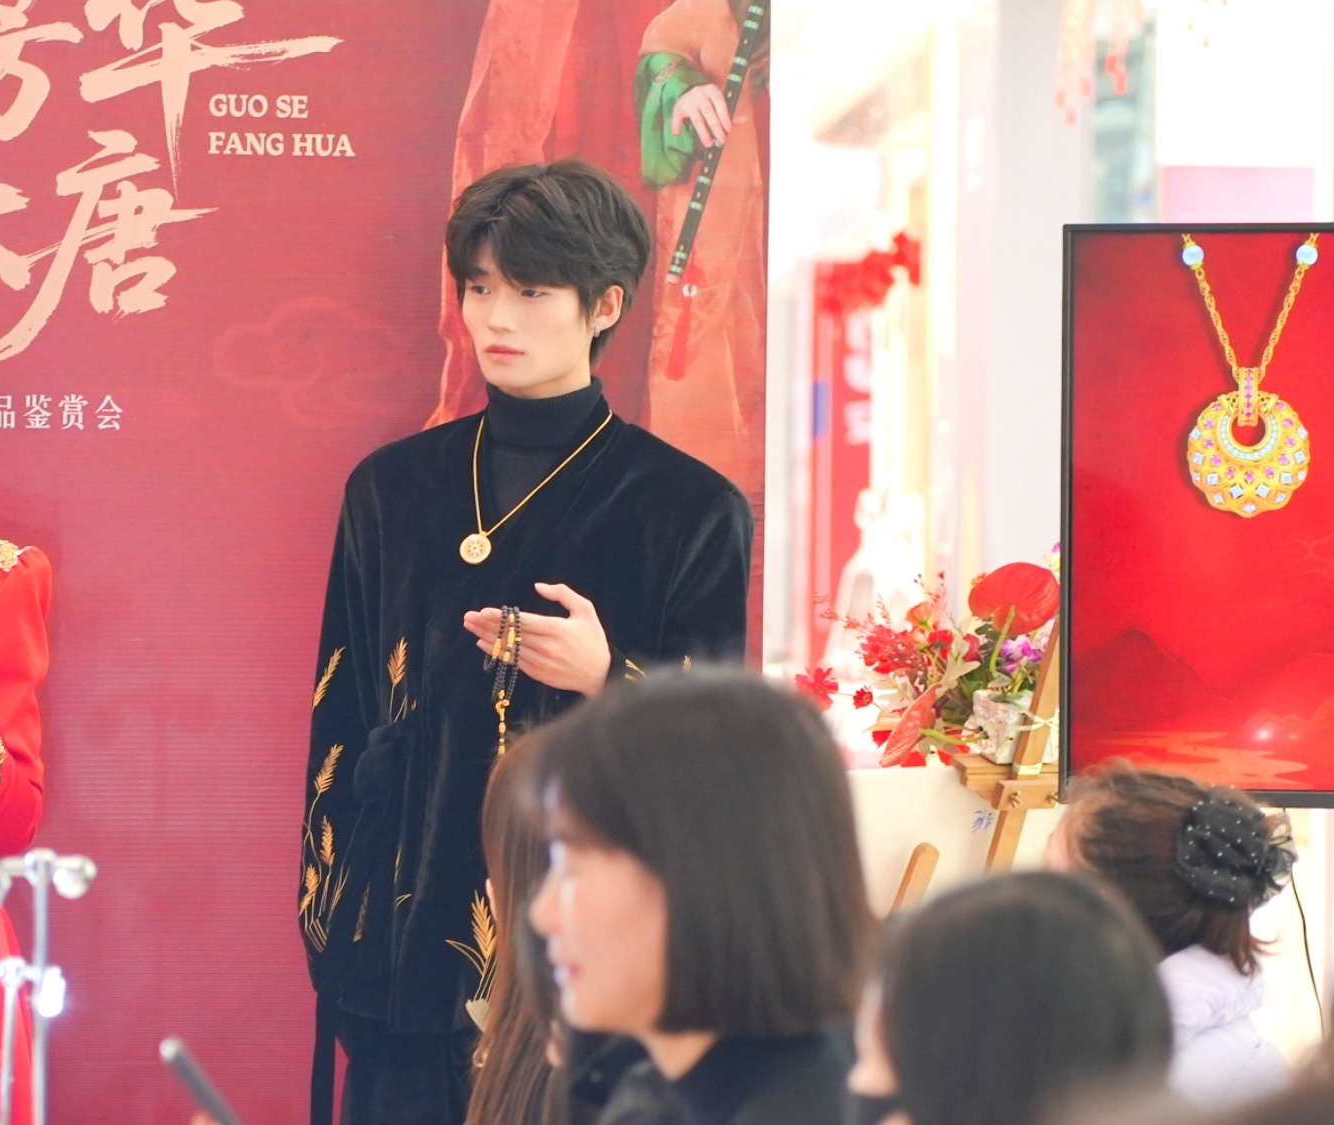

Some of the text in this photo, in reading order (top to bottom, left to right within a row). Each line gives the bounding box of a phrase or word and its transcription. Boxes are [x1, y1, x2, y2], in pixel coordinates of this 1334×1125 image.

[208, 93, 309, 119] GUO SE
[208, 131, 356, 157] FANG HUA
